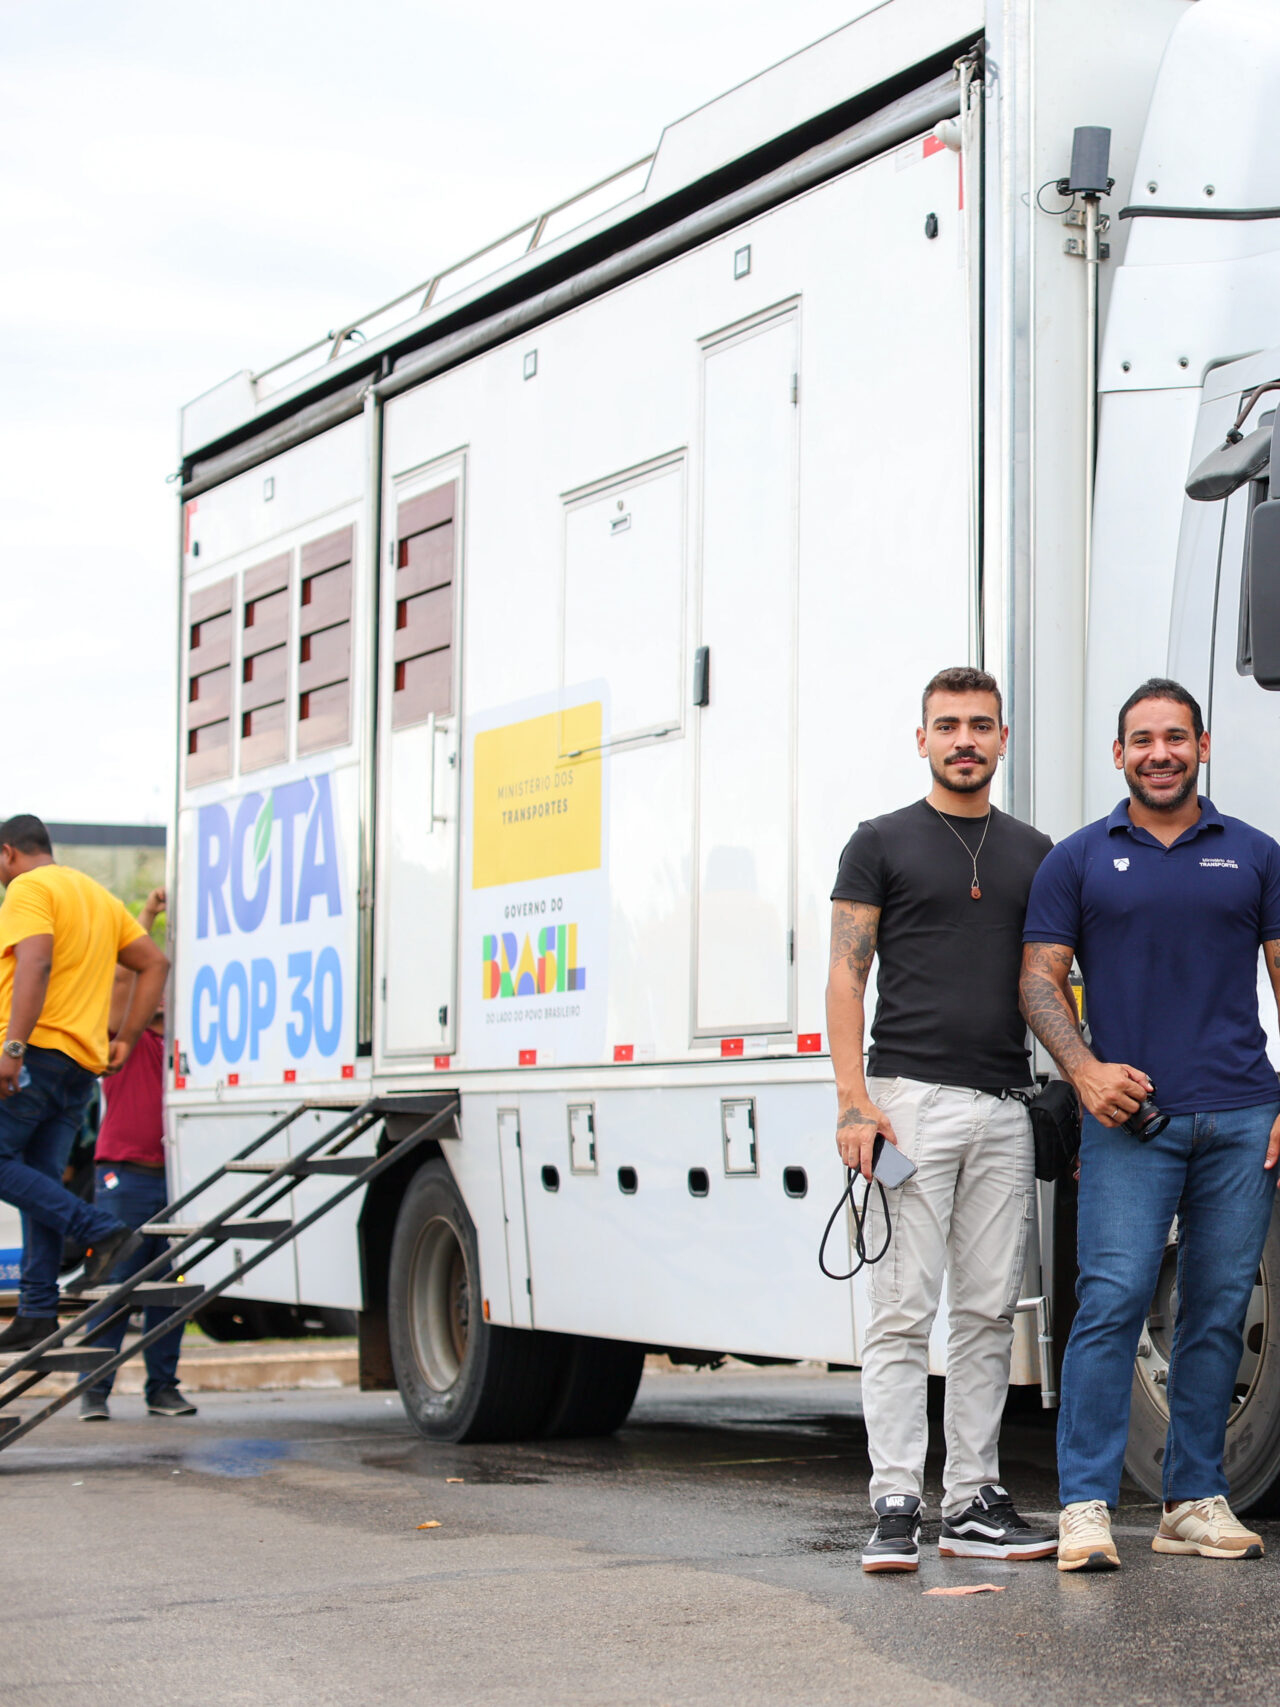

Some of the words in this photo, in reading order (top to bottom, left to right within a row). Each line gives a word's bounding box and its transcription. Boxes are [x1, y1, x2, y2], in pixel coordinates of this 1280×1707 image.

[498, 775, 551, 799] MINISTÉRIO
[554, 769, 573, 788] DOS
[502, 798, 568, 825] TRANSPORTES
[196, 772, 342, 940] ROTA
[504, 900, 547, 919] GOVERNO
[551, 897, 563, 912] DO
[482, 922, 586, 1000] BRASIL
[191, 957, 277, 1066] COP
[286, 945, 343, 1059] 30
[886, 1496, 905, 1507] VANS
